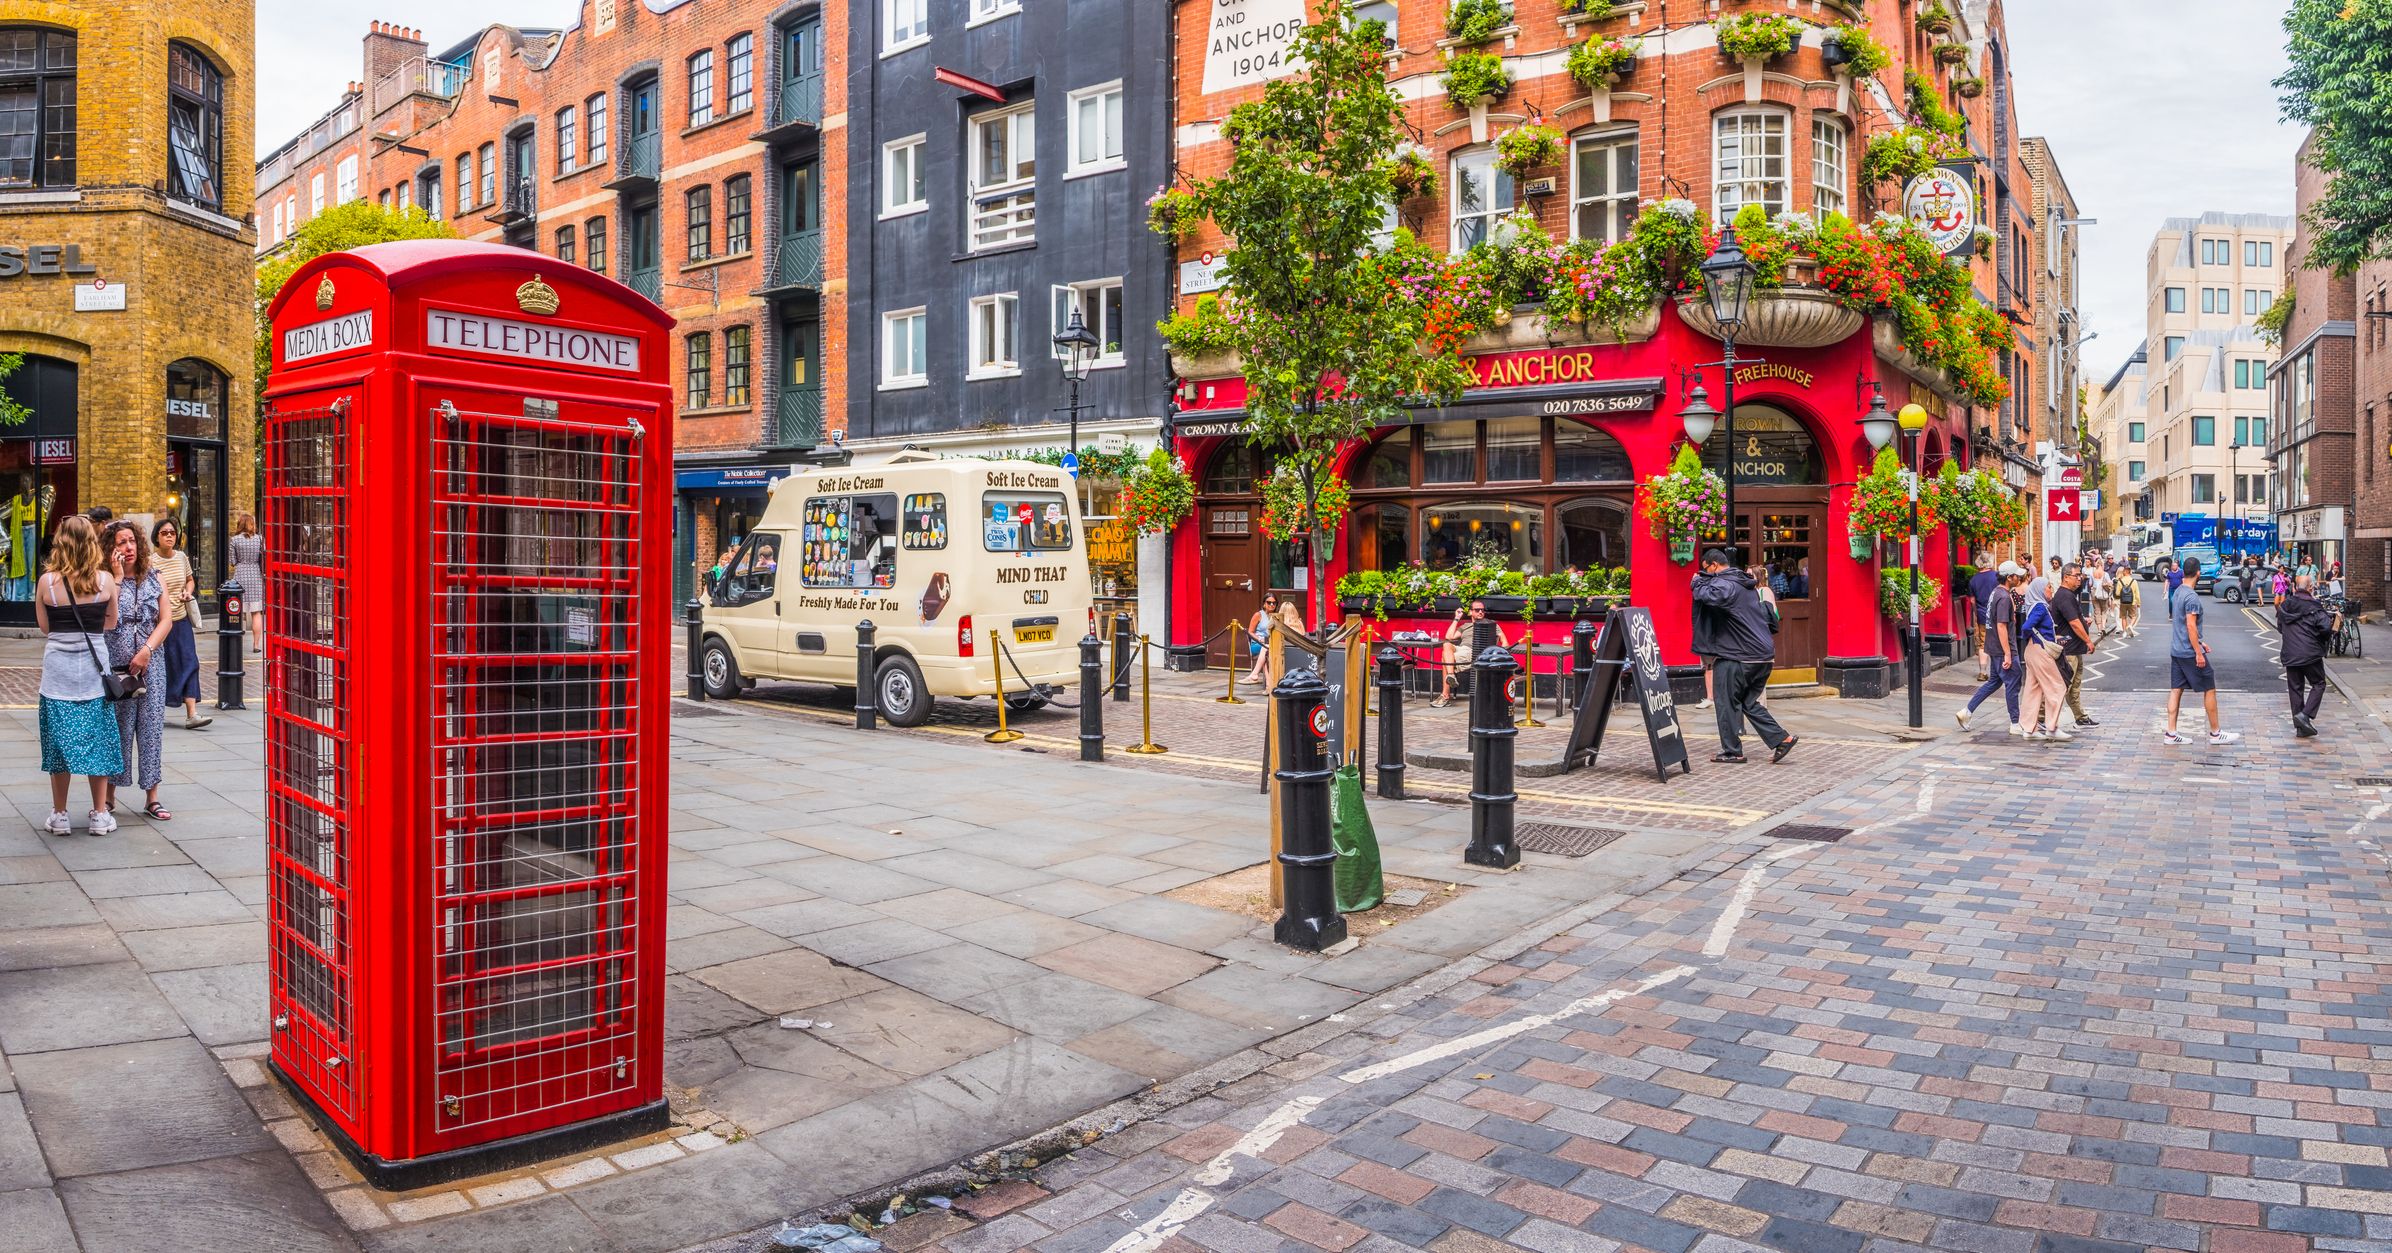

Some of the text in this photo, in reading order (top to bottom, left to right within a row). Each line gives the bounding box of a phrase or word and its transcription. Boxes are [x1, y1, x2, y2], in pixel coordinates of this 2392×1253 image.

[1216, 11, 1245, 29] AND
[1212, 18, 1302, 56] ANCHOR
[1233, 50, 1280, 77] 1904
[1185, 279, 1212, 288] STREET
[287, 313, 372, 360] MEDIA BOXX
[435, 314, 632, 367] TELEPHONE
[1487, 352, 1595, 386] ANCHOR
[1734, 363, 1814, 389] FREEHOUSE
[1544, 396, 1643, 414] 020 7836 5649
[1184, 423, 1229, 436] CROWN
[1230, 422, 1241, 434] &
[1736, 417, 1783, 431] ROWN
[1747, 436, 1763, 457] &
[1723, 461, 1786, 476] NCHOR
[817, 475, 884, 493] Soft Ice Cream
[986, 471, 1059, 488] Soft Ice Cream
[987, 533, 1007, 542] CONES
[996, 566, 1067, 584] MIND THAT
[800, 595, 899, 611] Freshly Made For You
[1023, 589, 1049, 605] CHILD
[1018, 631, 1036, 642] LN07
[1645, 687, 1673, 717] Vintage
